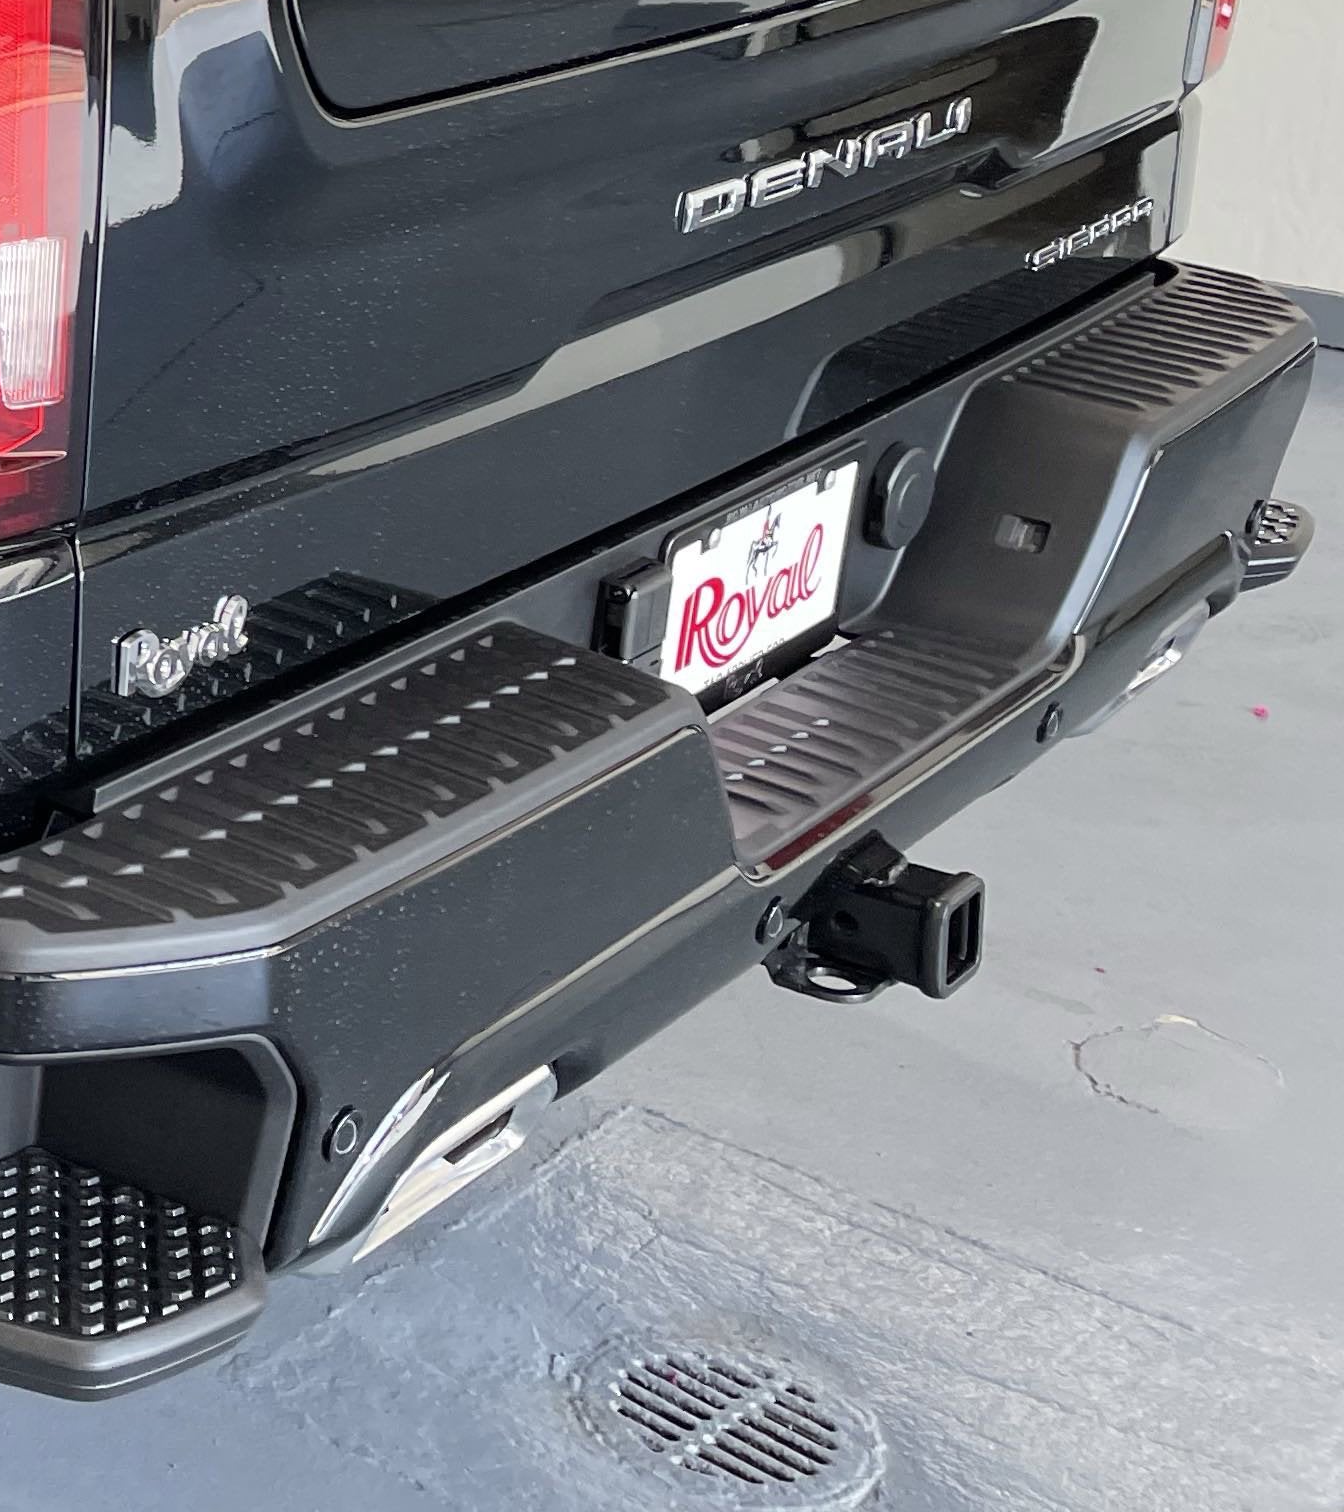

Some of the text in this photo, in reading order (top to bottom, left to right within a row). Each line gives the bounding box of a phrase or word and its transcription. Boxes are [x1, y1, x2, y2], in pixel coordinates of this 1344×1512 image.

[674, 96, 973, 234] DENALI
[1025, 196, 1154, 271] SIERRA
[111, 595, 249, 698] Royal
[675, 523, 823, 673] Royal
